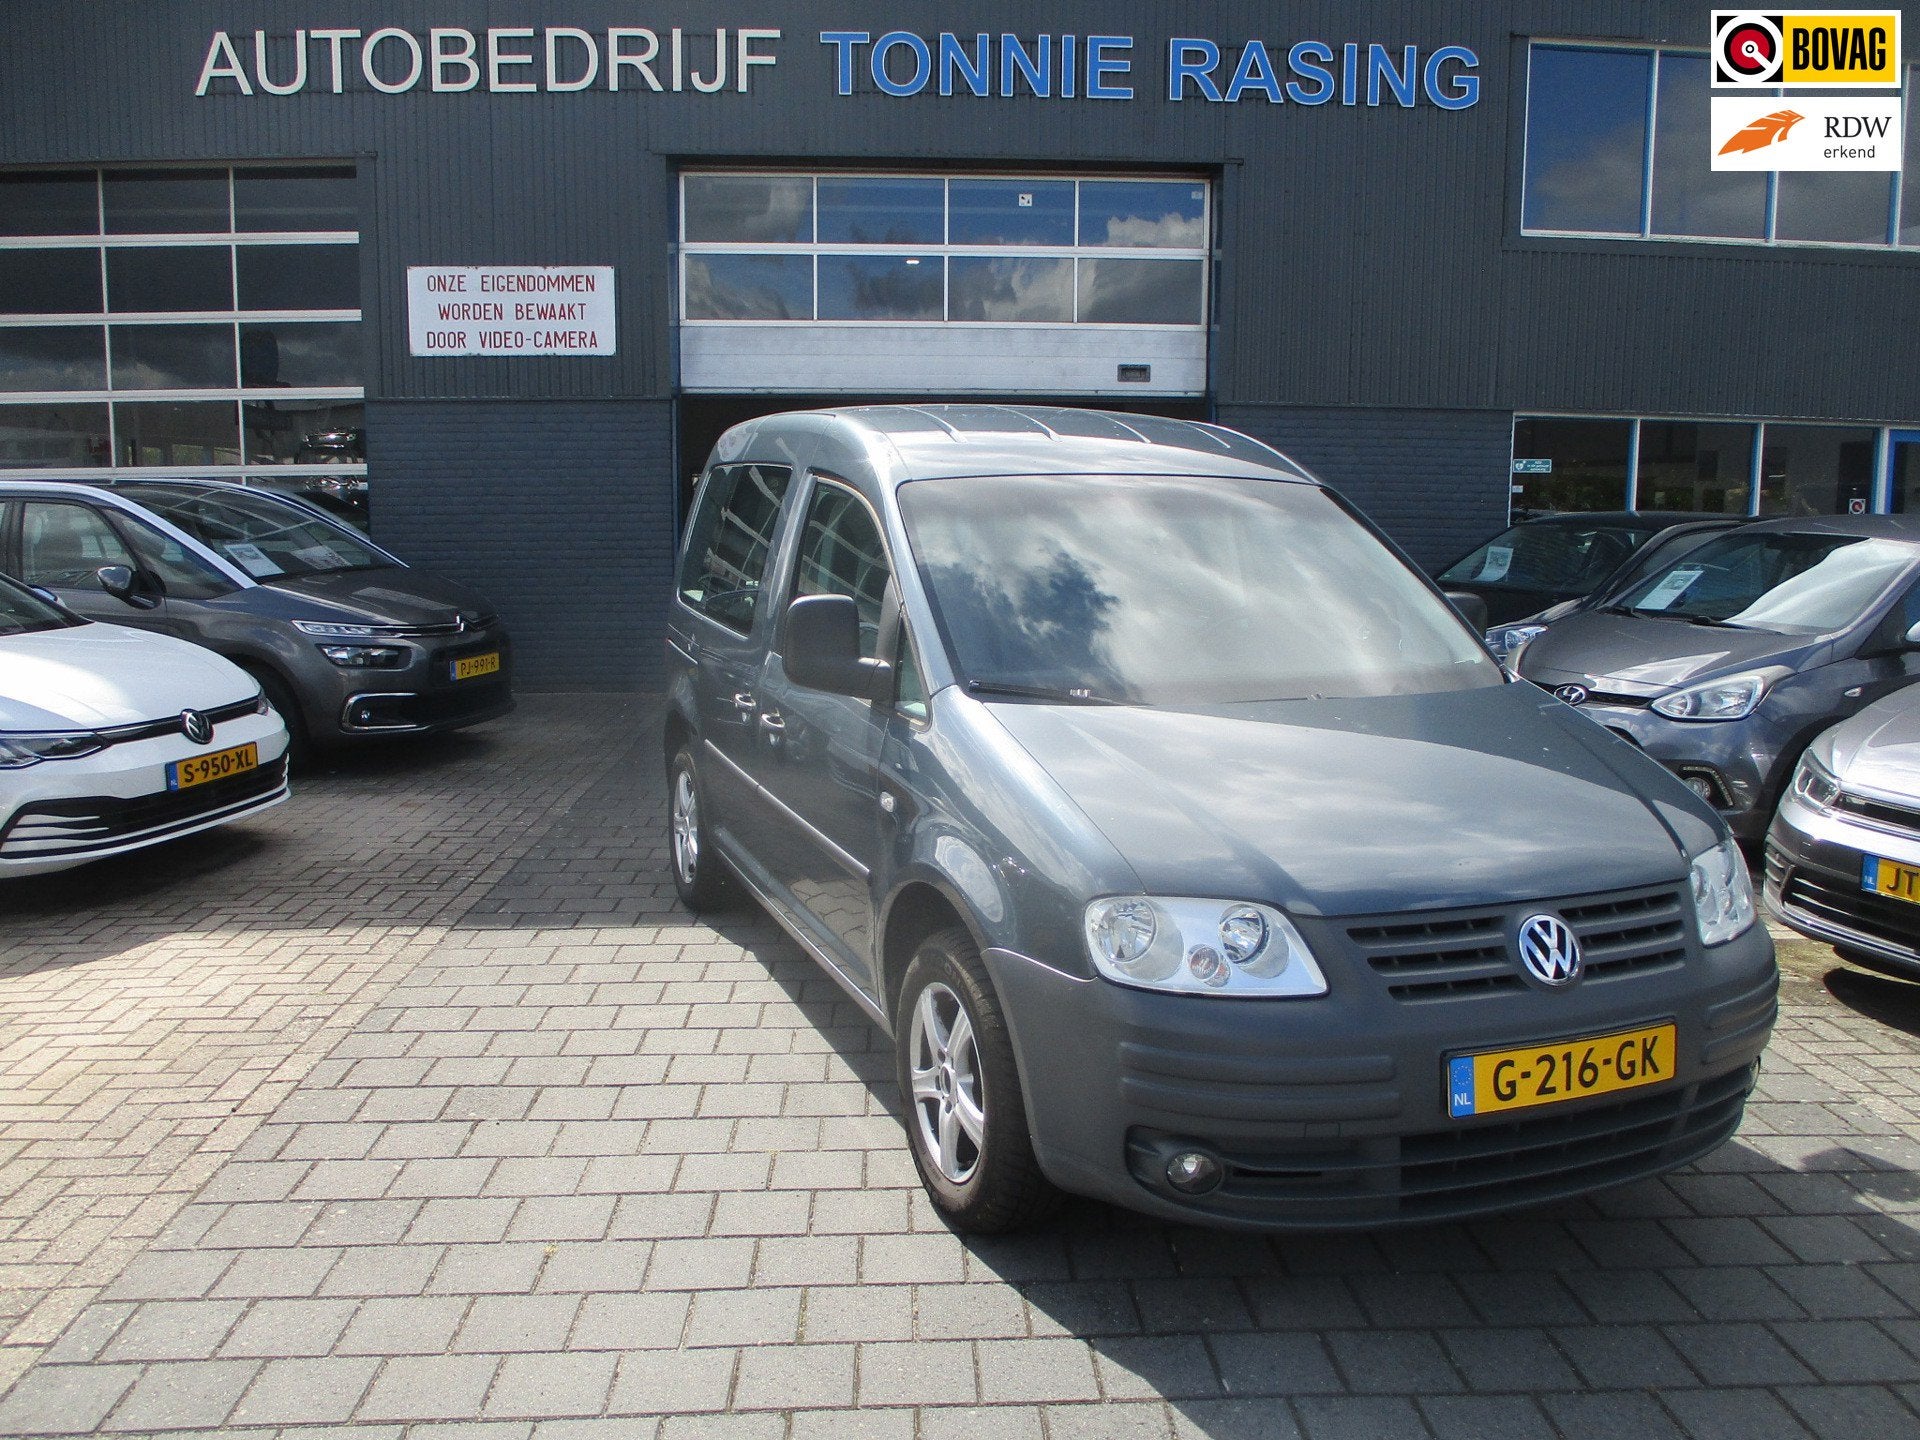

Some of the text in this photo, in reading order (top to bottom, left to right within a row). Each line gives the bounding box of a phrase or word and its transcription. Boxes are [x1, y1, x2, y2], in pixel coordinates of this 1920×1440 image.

[195, 27, 1480, 111] AUTOBEDRIJF TONNIE RASING
[427, 275, 595, 292] ONZE EIGENDOMMEN
[438, 303, 586, 320] WORDEN BEWAAKT
[427, 331, 598, 348] DOOR VIDEO-CAMERA
[183, 748, 254, 783] S-950-XL
[1454, 1035, 1659, 1106] NL G-216-GK
